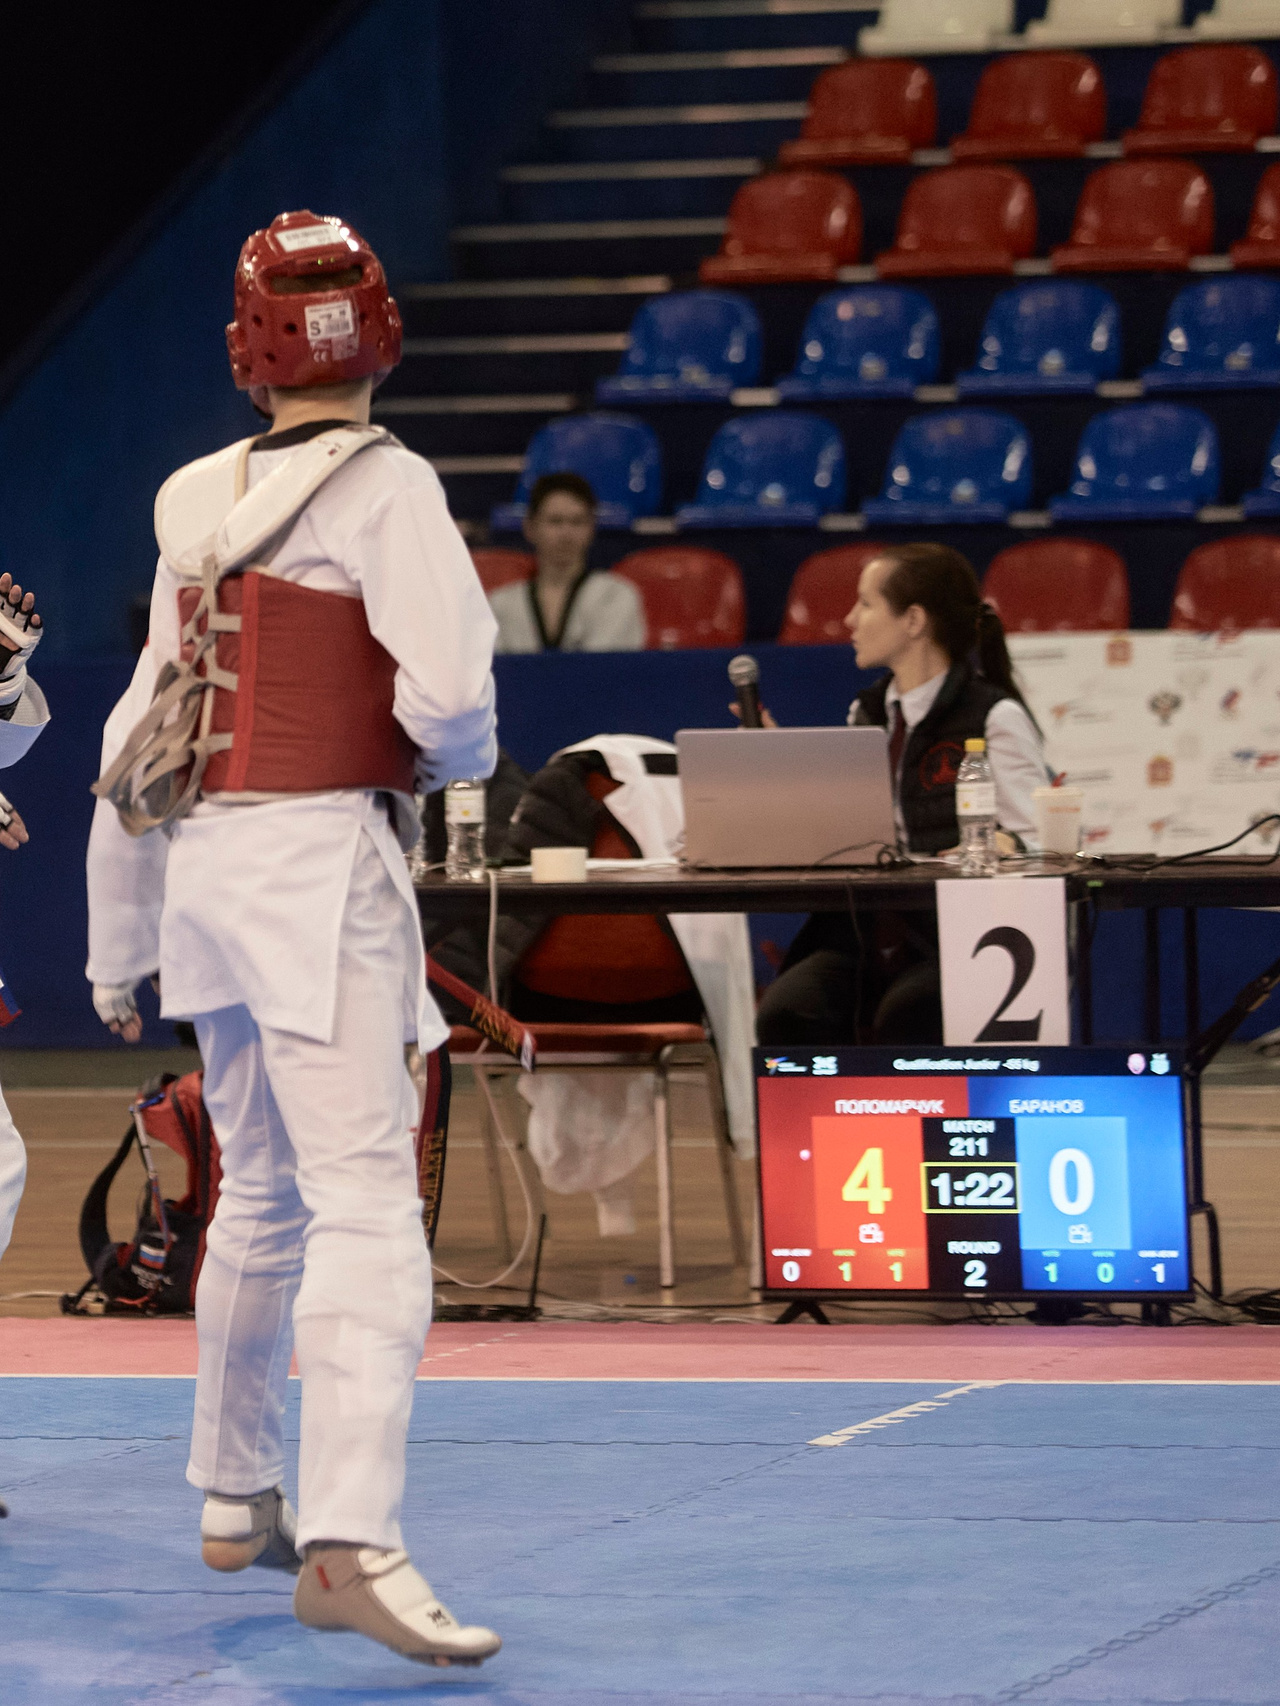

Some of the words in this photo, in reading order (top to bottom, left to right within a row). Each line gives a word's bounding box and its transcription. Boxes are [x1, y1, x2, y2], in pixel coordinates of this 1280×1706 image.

[971, 926, 1044, 1043] 2
[1009, 1099, 1085, 1115] БАРАНОВ
[942, 1120, 995, 1134] MATCH
[949, 1137, 988, 1157] 211
[841, 1147, 893, 1215] 4
[931, 1172, 1015, 1206] 1:22
[1048, 1147, 1095, 1216] 0
[947, 1241, 1001, 1255] ROUND
[782, 1260, 801, 1282] 0
[838, 1261, 852, 1282] 1
[889, 1261, 903, 1282] 1
[963, 1260, 988, 1287] 2
[1044, 1262, 1058, 1283] 1
[1096, 1262, 1115, 1284] 0
[1151, 1263, 1165, 1283] 1
